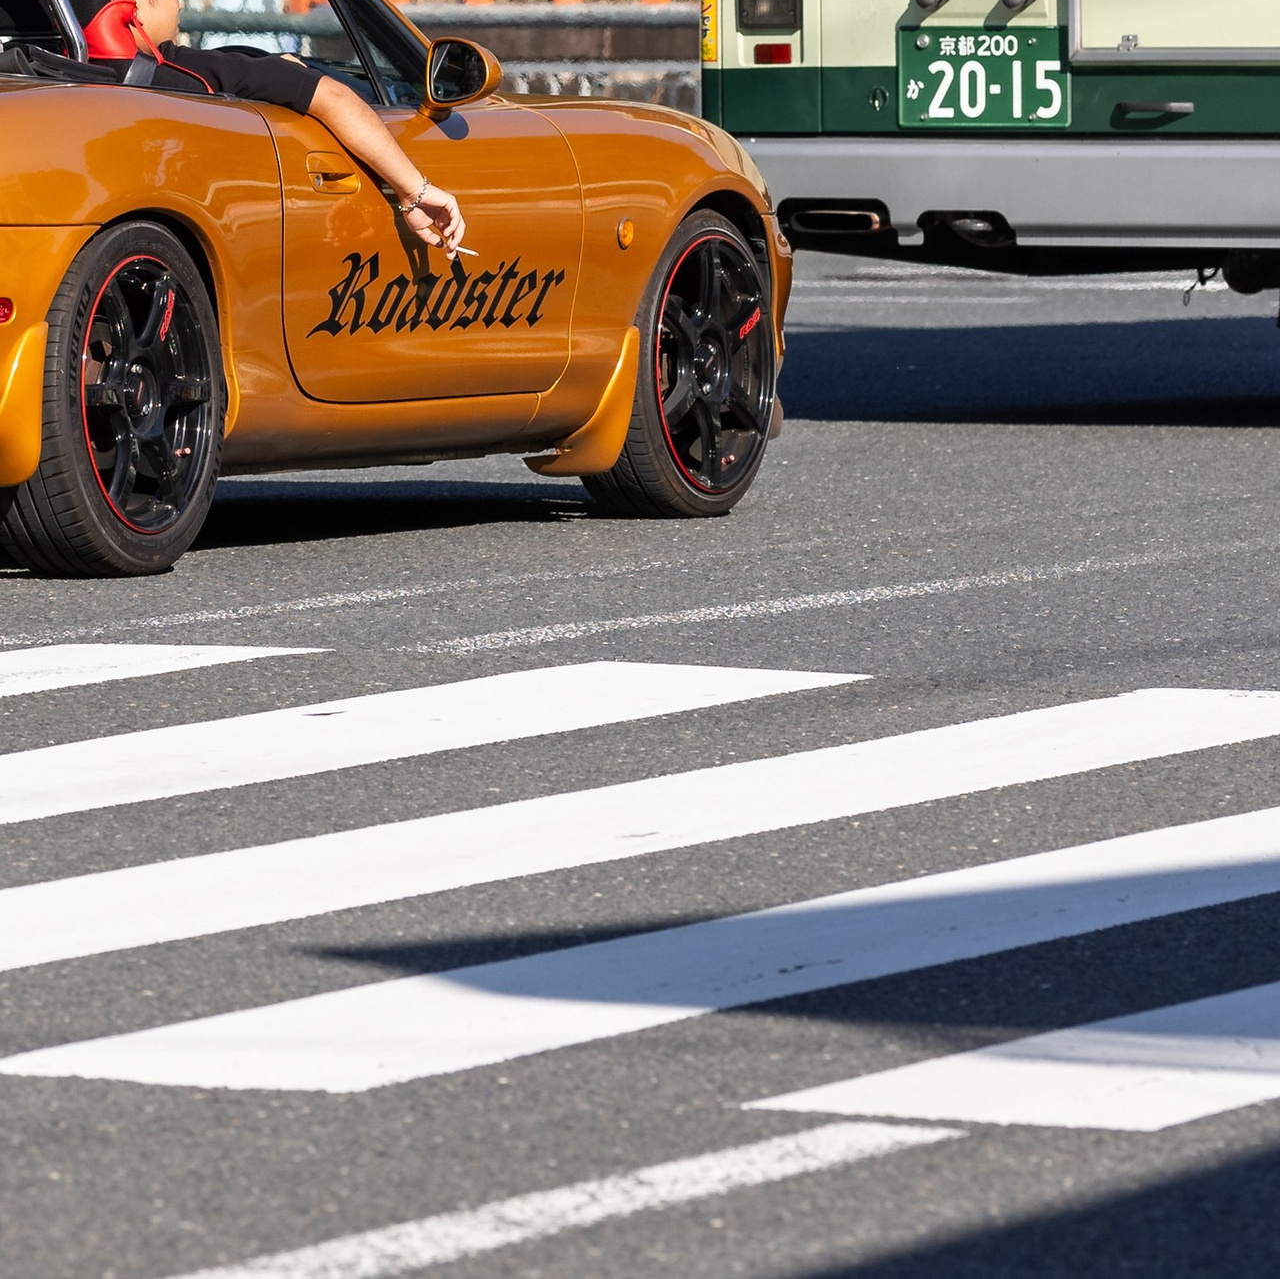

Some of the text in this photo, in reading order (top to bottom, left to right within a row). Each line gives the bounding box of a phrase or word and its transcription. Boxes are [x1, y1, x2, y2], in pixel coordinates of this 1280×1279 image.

[906, 60, 1062, 119] か 20-15
[306, 251, 565, 338] Roadster
